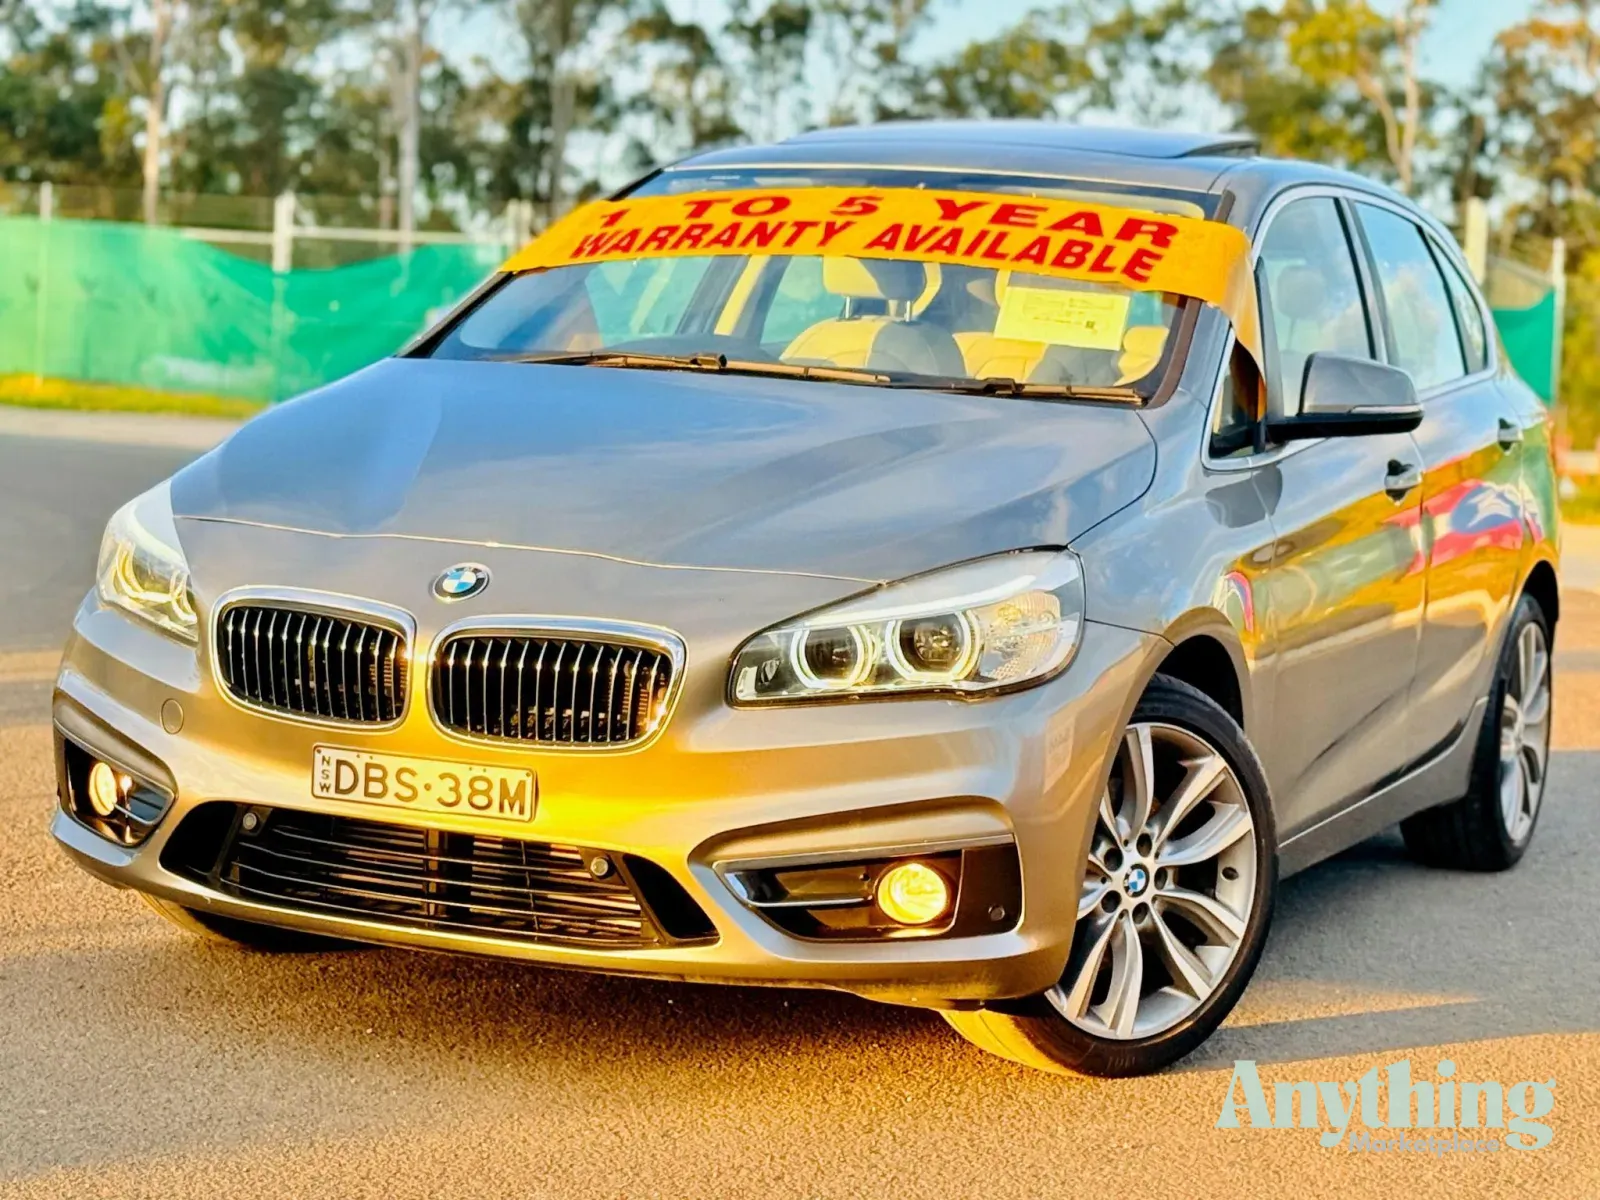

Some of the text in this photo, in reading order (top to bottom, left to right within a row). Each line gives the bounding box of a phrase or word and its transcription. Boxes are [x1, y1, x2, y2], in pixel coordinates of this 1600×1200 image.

[600, 195, 1180, 250] 1 TO 5 YEAR
[569, 220, 1165, 284] WARRANTY AVAILABLE
[319, 754, 331, 794] NSW
